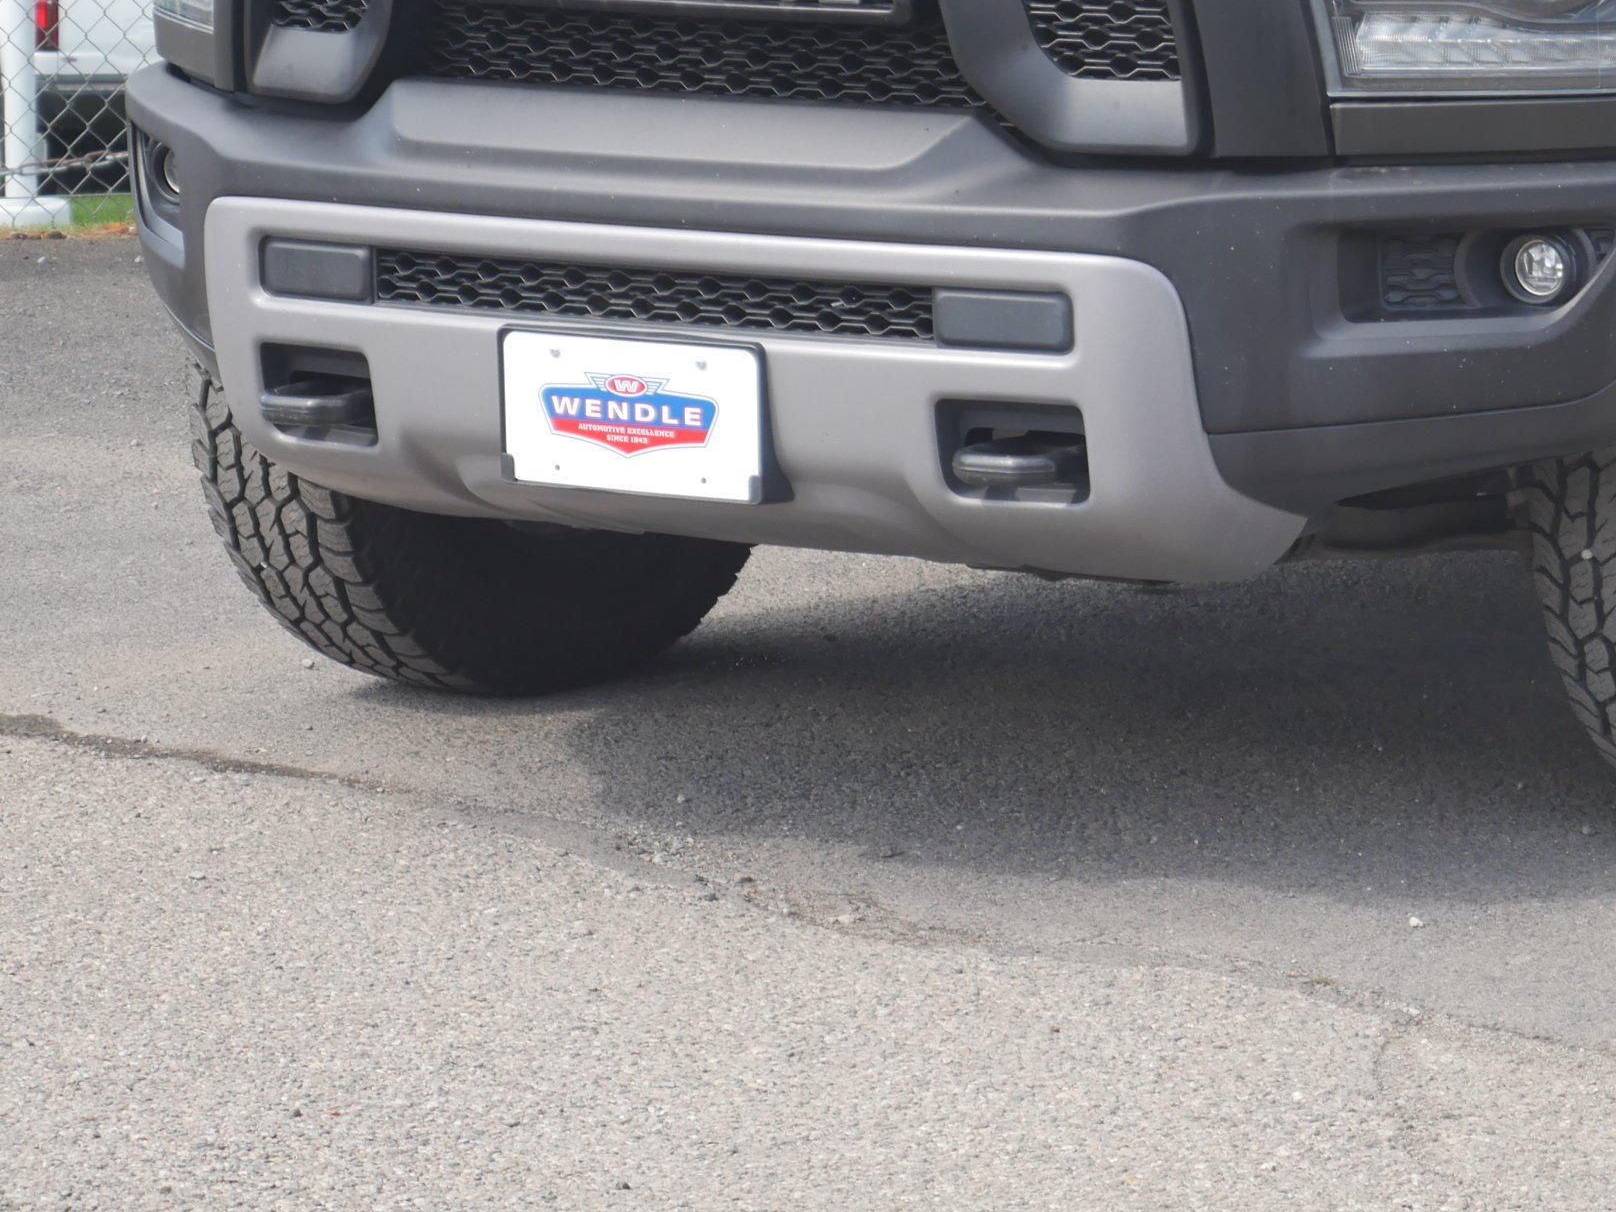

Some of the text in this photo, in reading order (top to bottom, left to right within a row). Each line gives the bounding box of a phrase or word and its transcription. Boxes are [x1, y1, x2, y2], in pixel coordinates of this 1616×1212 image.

[551, 395, 702, 426] WENDLE
[578, 422, 676, 439] AUTOMOTIVE EXCELLENCE
[606, 434, 630, 444] SINCE
